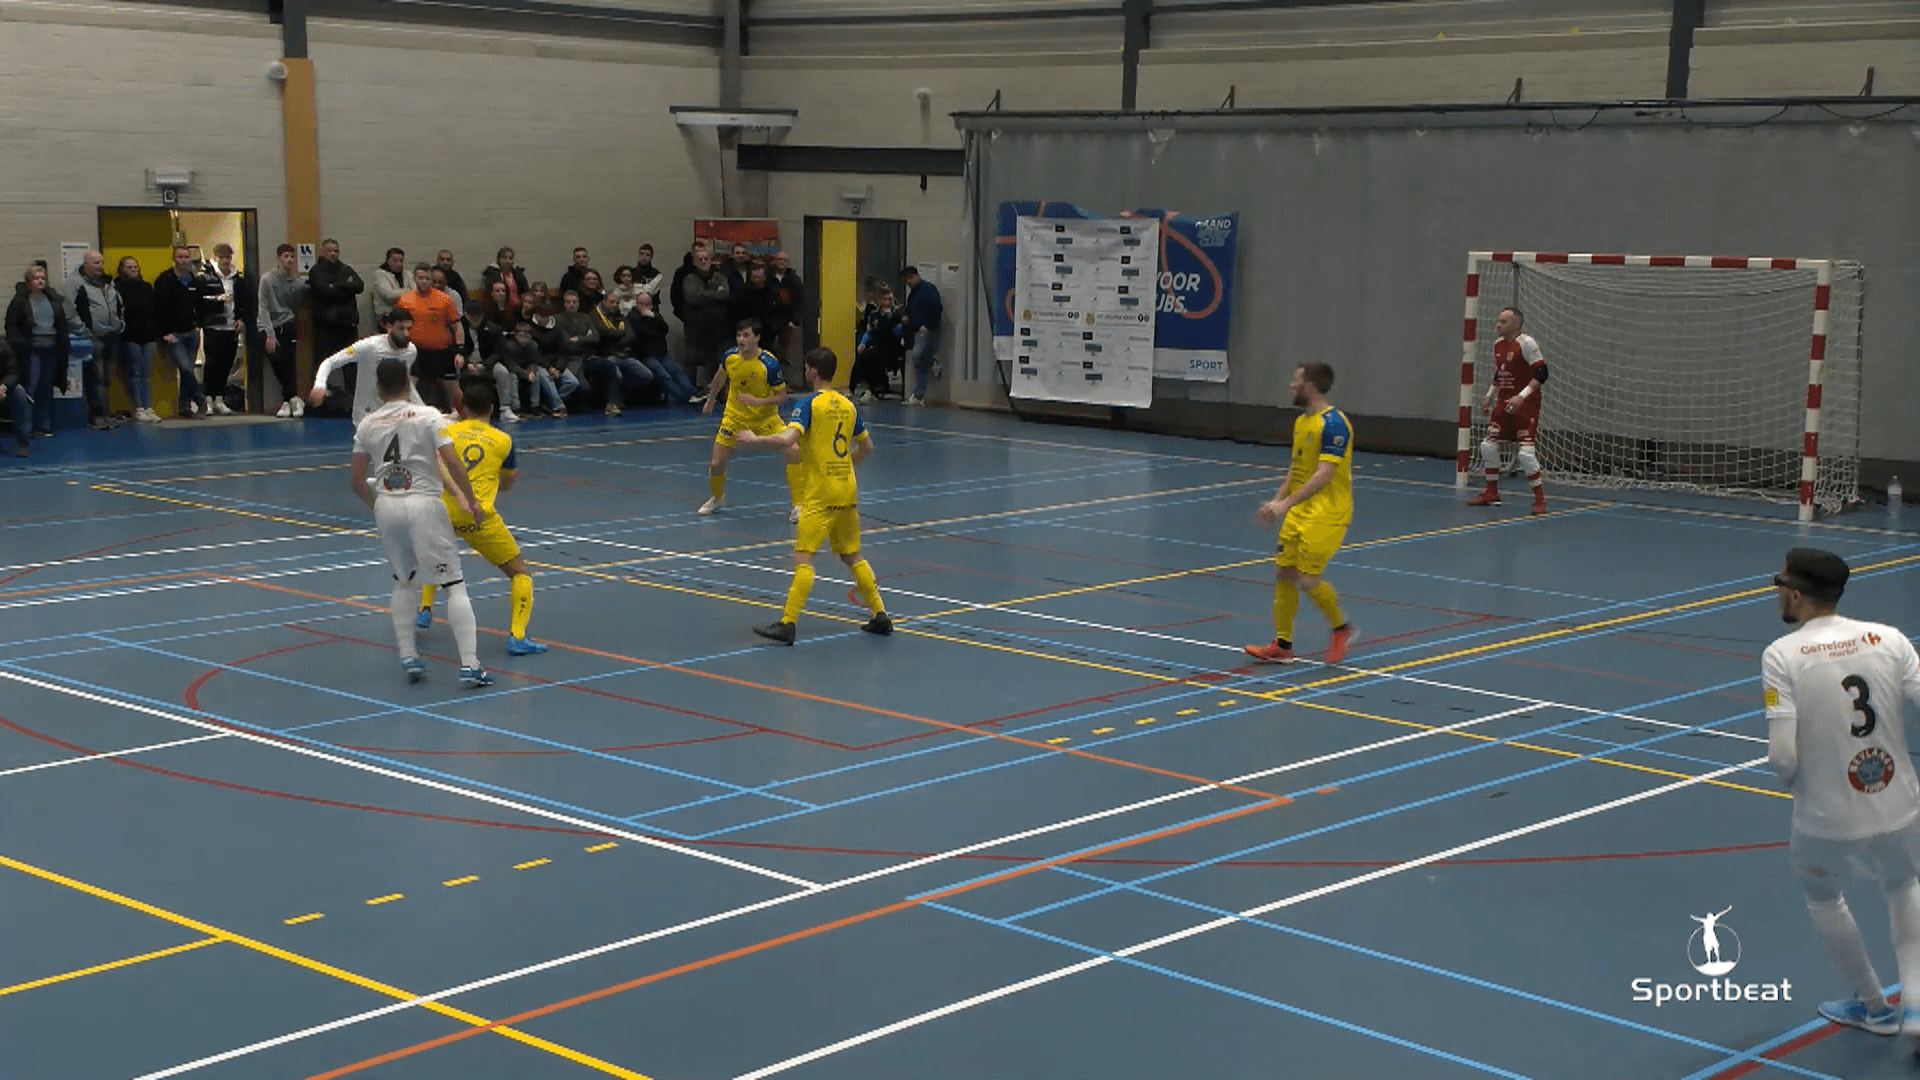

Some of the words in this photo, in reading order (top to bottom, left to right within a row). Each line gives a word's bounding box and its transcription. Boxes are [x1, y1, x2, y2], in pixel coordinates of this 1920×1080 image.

[1190, 359, 1223, 370] SPORT
[383, 432, 402, 464] 4
[833, 421, 848, 457] 6
[464, 444, 484, 471] 9
[1801, 638, 1857, 655] Carrefour
[1840, 674, 1876, 738] 3
